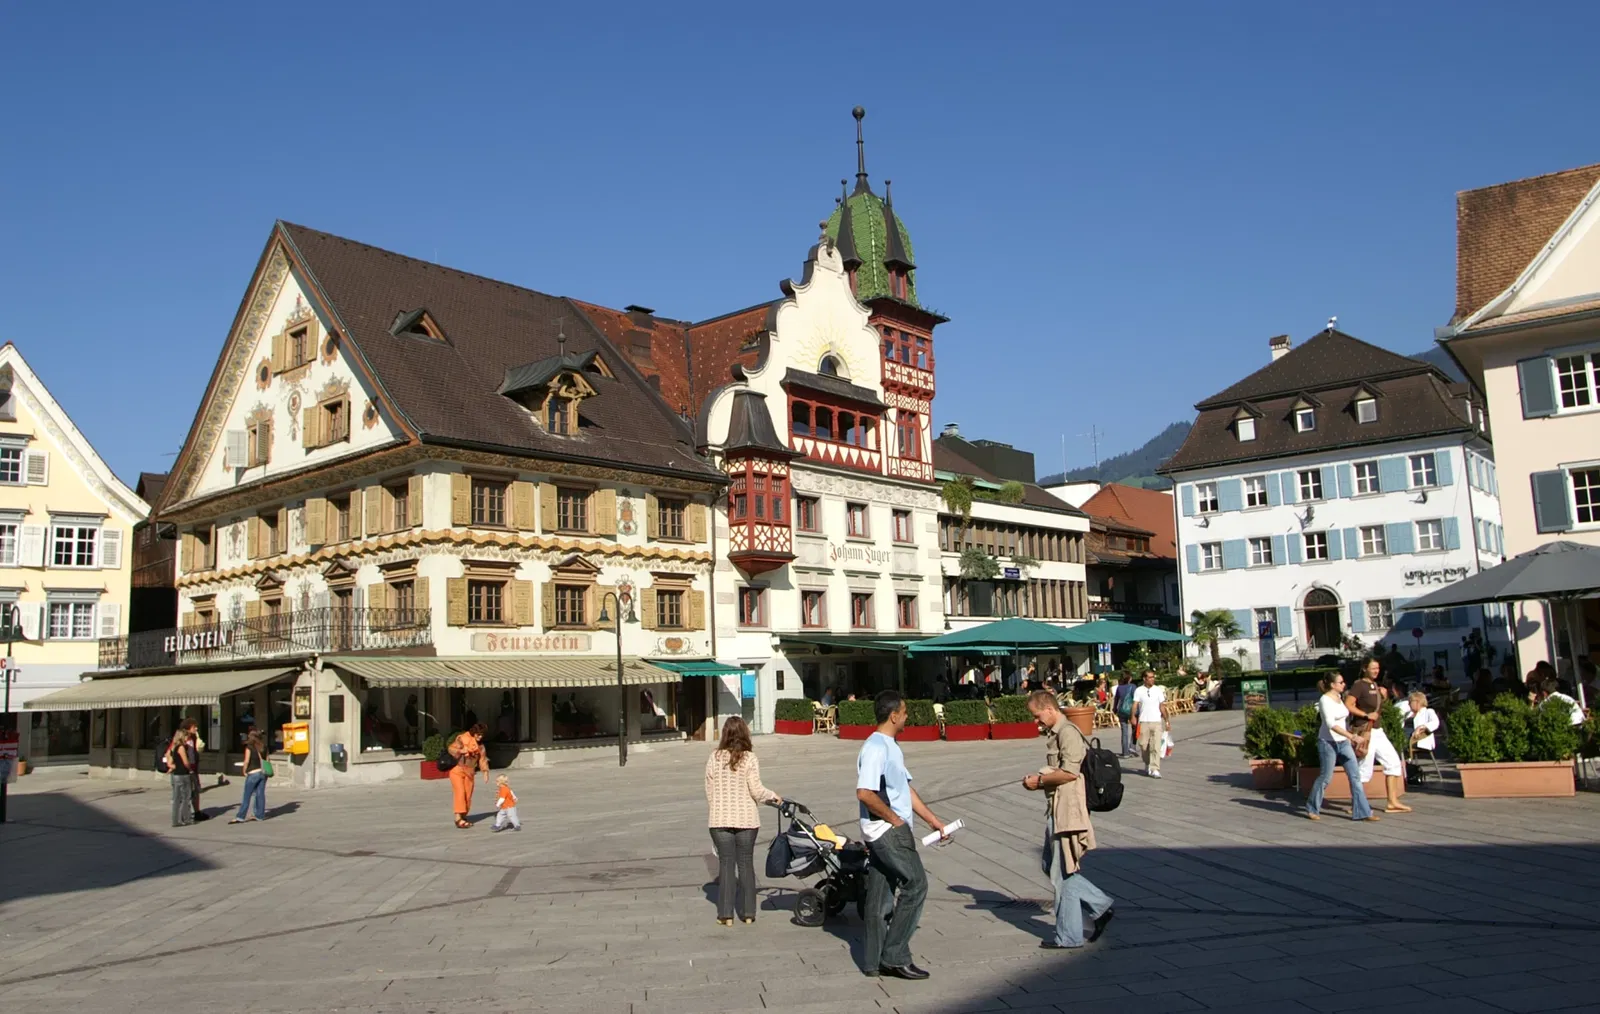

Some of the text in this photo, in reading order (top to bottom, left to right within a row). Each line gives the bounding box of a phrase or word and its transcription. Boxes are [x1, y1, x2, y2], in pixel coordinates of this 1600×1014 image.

[830, 542, 863, 562] Johann
[164, 629, 227, 652] FEURSTEIN
[487, 633, 578, 652] Feurstein
